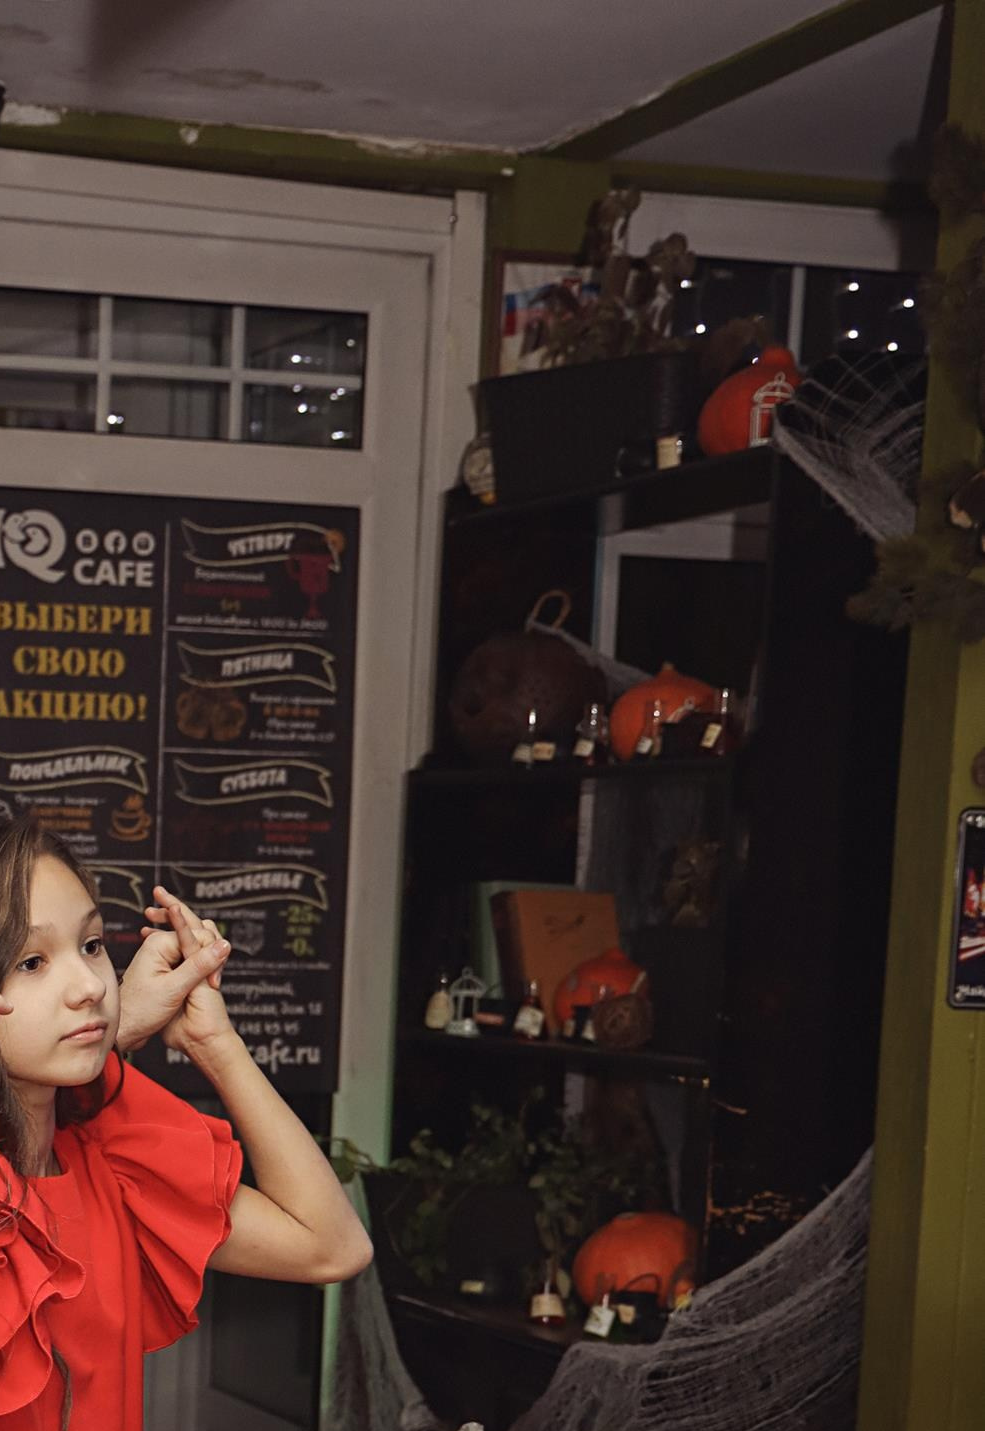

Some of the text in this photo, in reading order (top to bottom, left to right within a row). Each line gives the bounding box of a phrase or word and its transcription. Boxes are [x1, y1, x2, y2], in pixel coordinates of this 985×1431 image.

[227, 532, 296, 557] ЧЕТВЕРГ
[73, 558, 155, 587] CAFE
[13, 645, 126, 678] СВОЮ
[221, 652, 294, 677] ПЯТНИЦА
[9, 755, 132, 781] ПОНЕДЕЛЬНИК
[220, 769, 288, 794] СУББОТА
[195, 871, 304, 898] ВОСКРЕСЕНЬЕ
